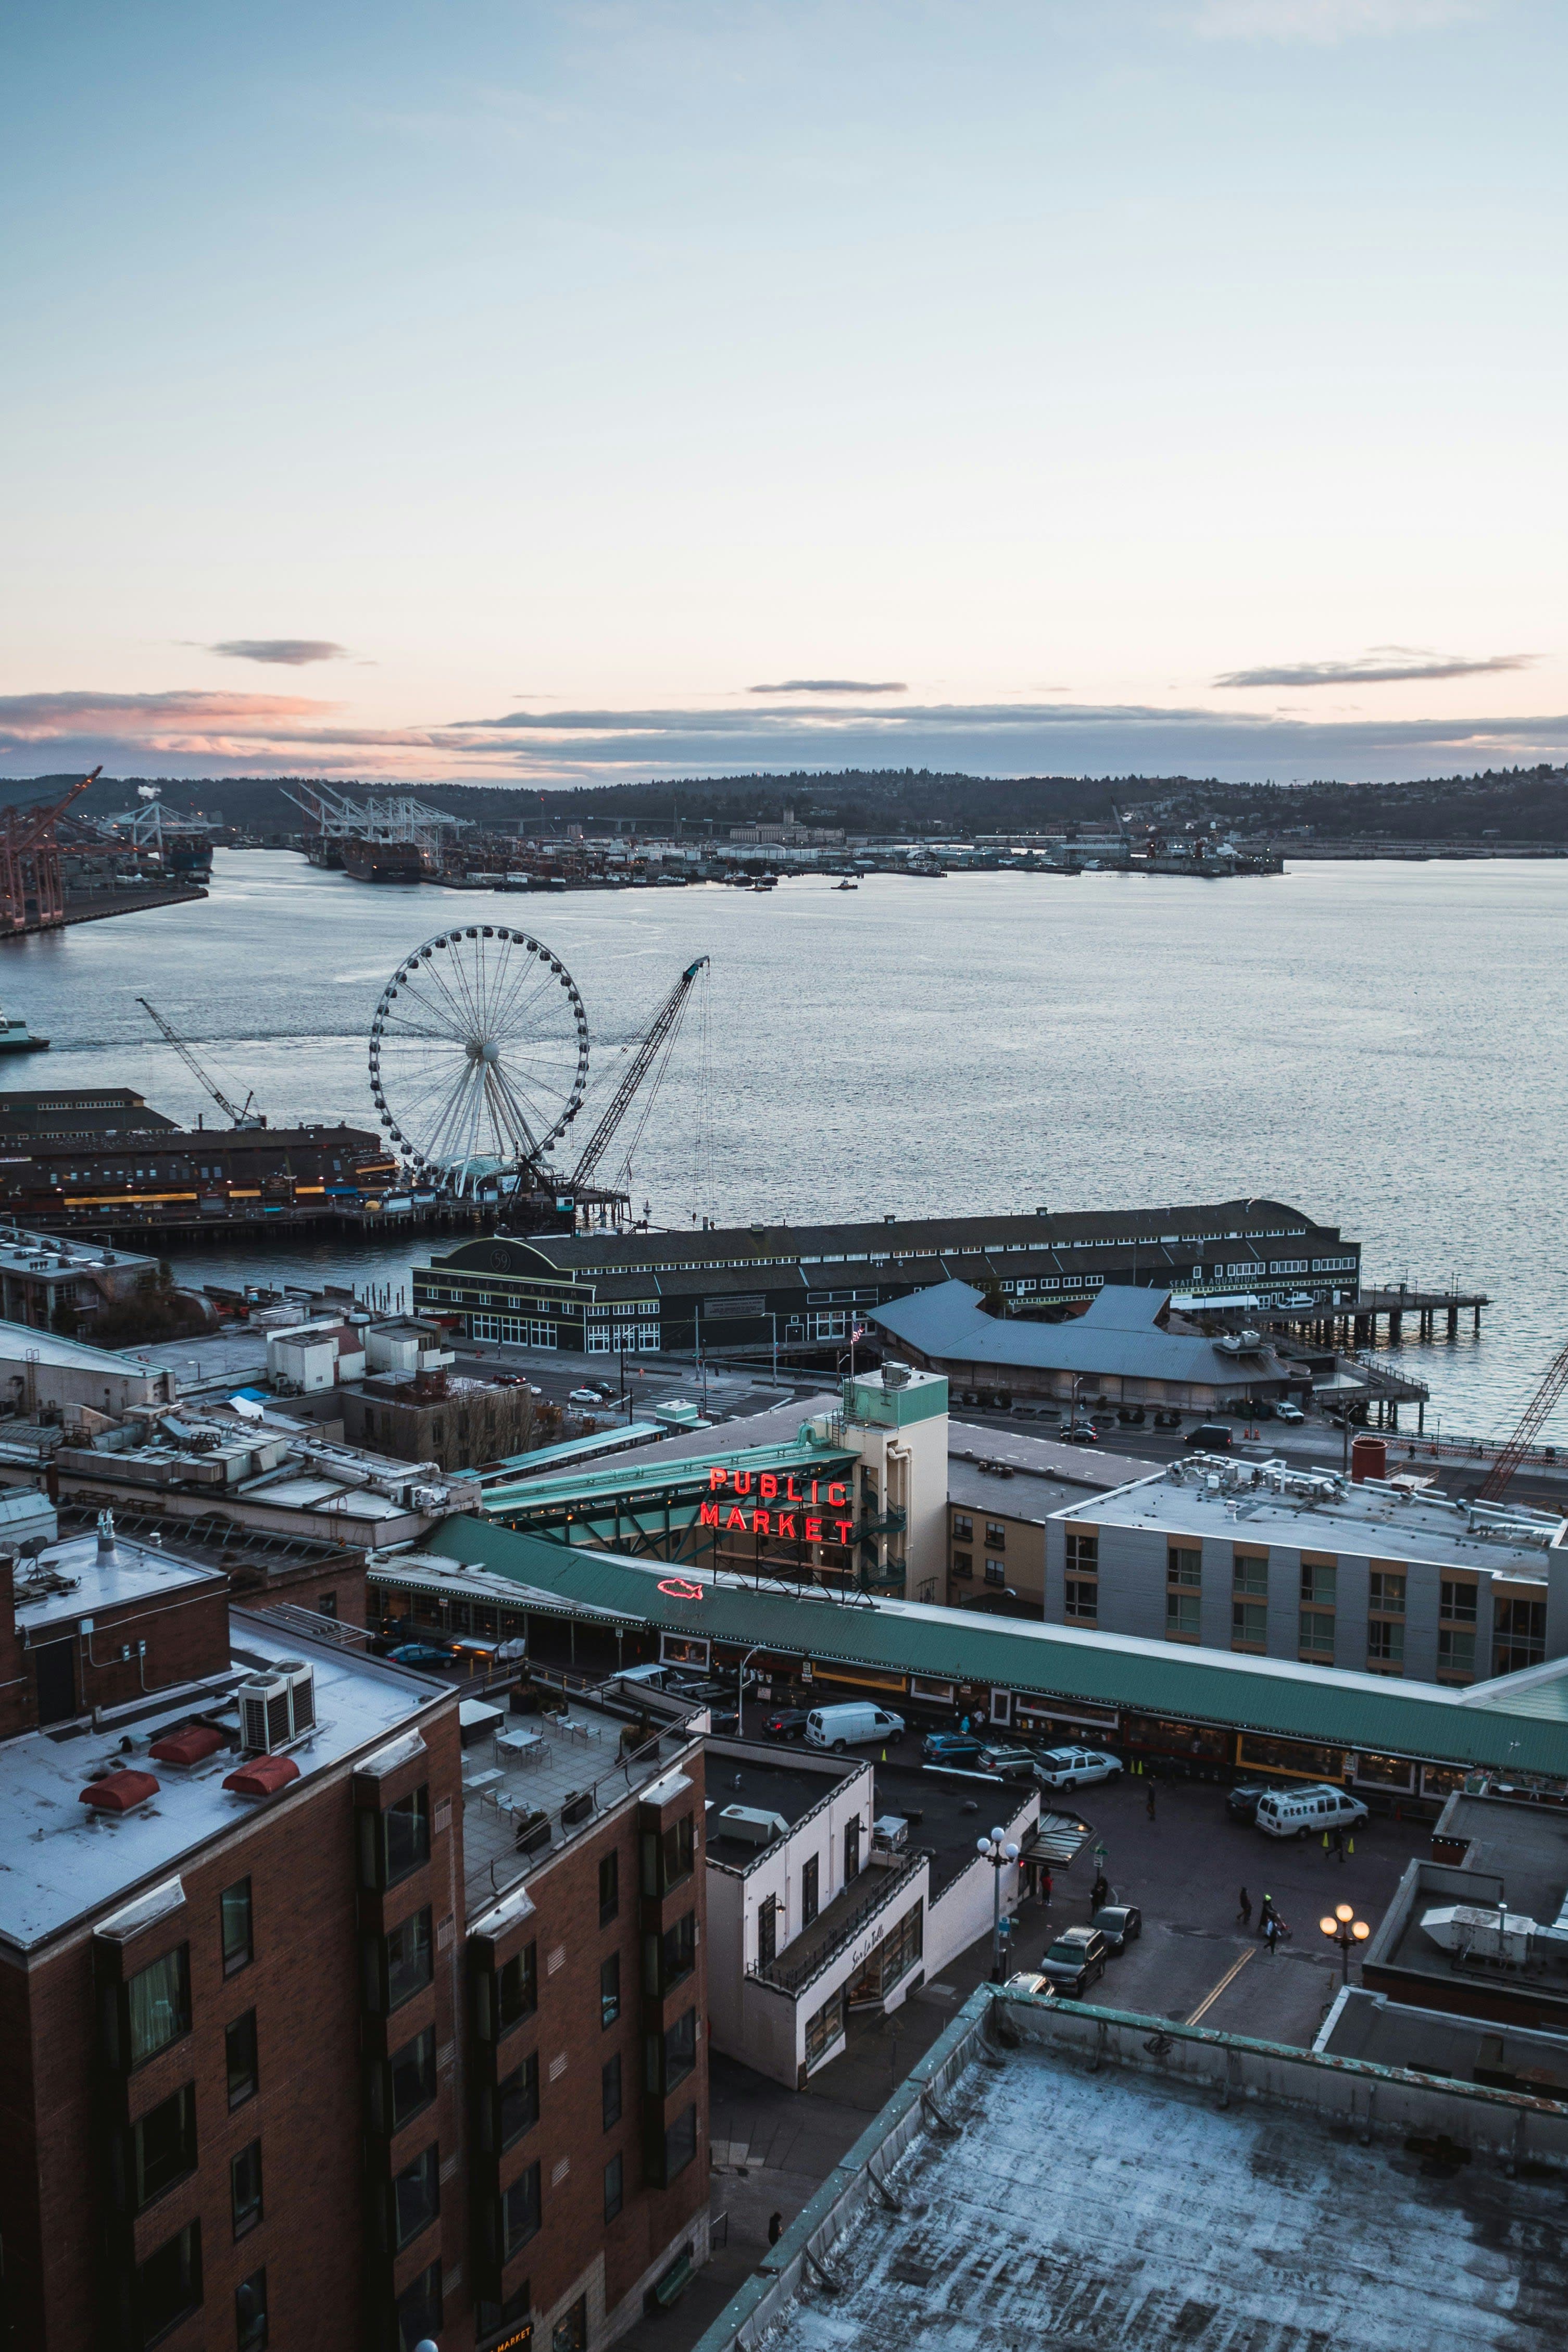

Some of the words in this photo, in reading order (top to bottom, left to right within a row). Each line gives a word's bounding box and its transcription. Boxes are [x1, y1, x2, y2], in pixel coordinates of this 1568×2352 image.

[495, 1253, 508, 1270] 59
[427, 1274, 491, 1289] SEATTLE
[498, 1282, 577, 1299] AQUARIUM
[1170, 1278, 1205, 1288] SEATTLE
[1209, 1275, 1258, 1285] AQUARIUM
[710, 1467, 846, 1507] PUBLIC
[700, 1502, 854, 1544] MARKET
[497, 2326, 531, 2352] MARKET
